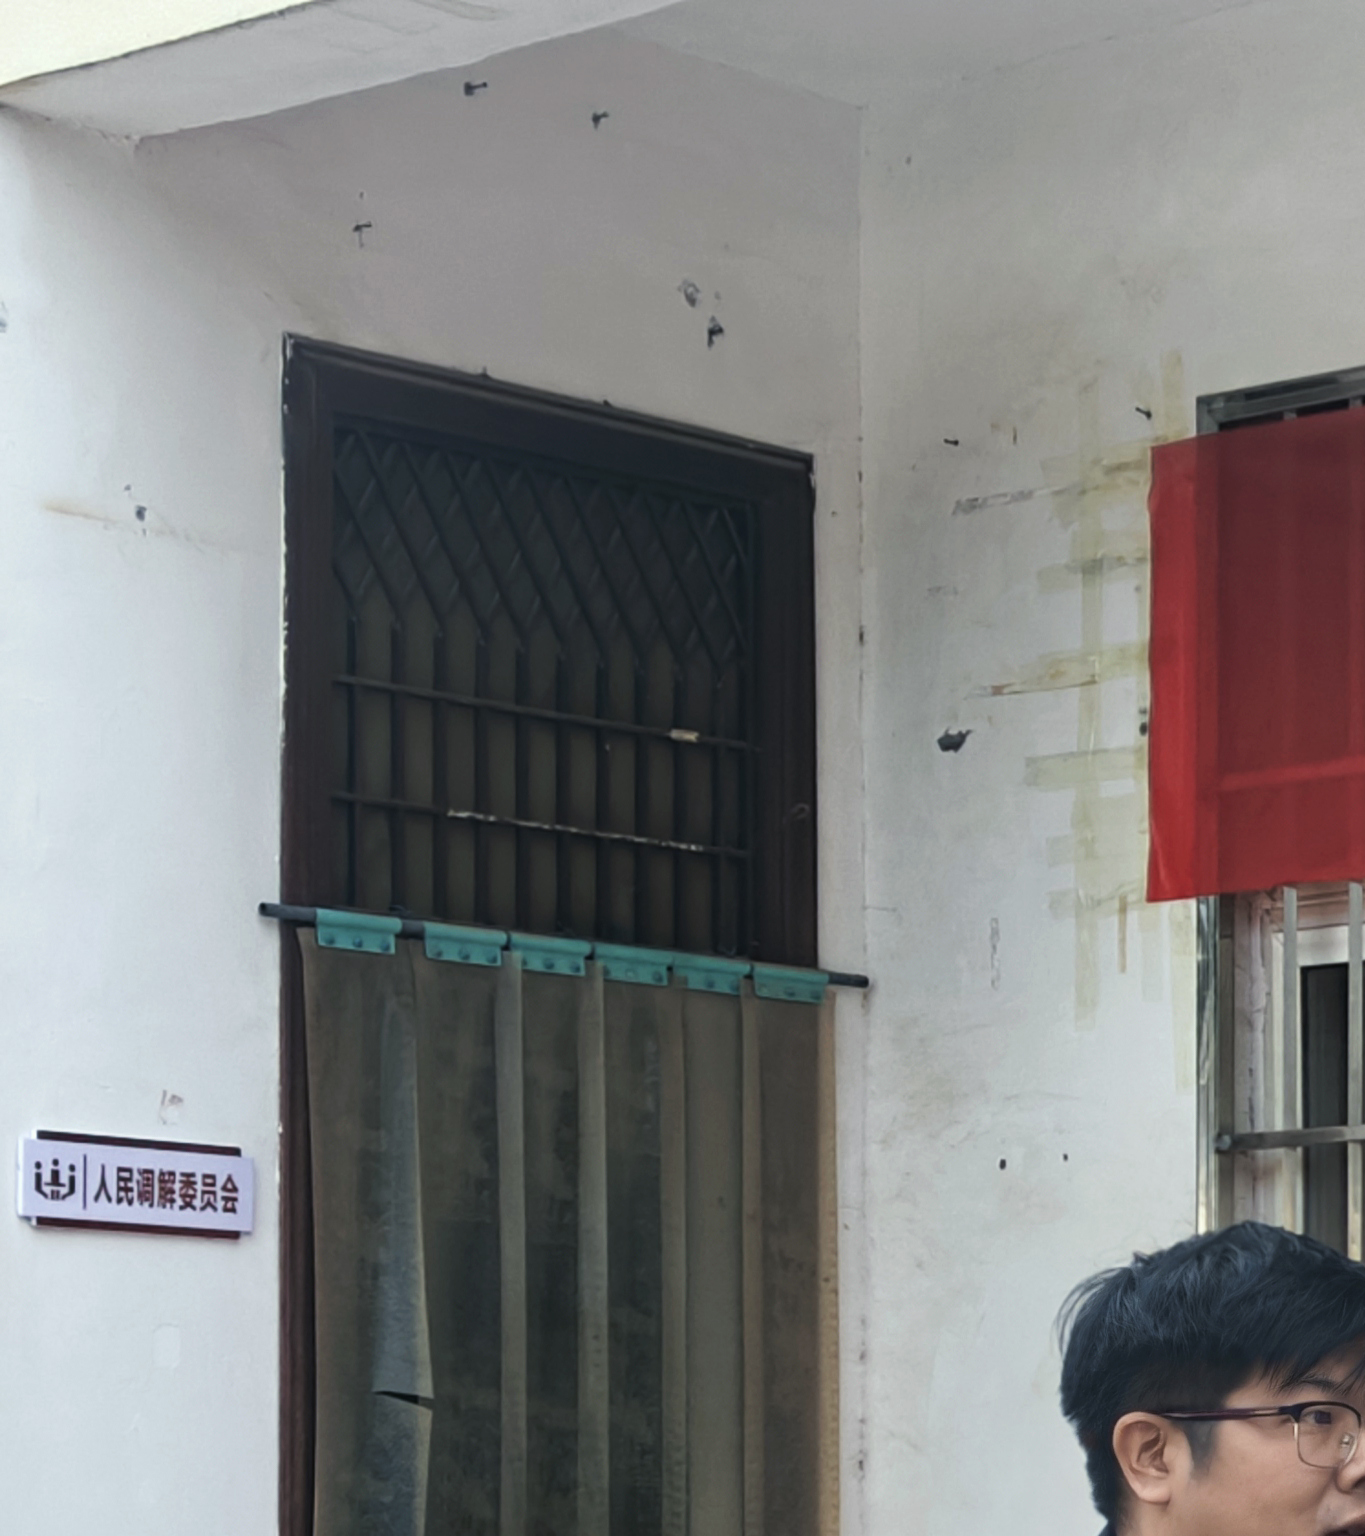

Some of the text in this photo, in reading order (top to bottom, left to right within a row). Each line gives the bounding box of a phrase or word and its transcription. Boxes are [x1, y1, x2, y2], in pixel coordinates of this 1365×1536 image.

[94, 1163, 240, 1214] 人民调解委员会
